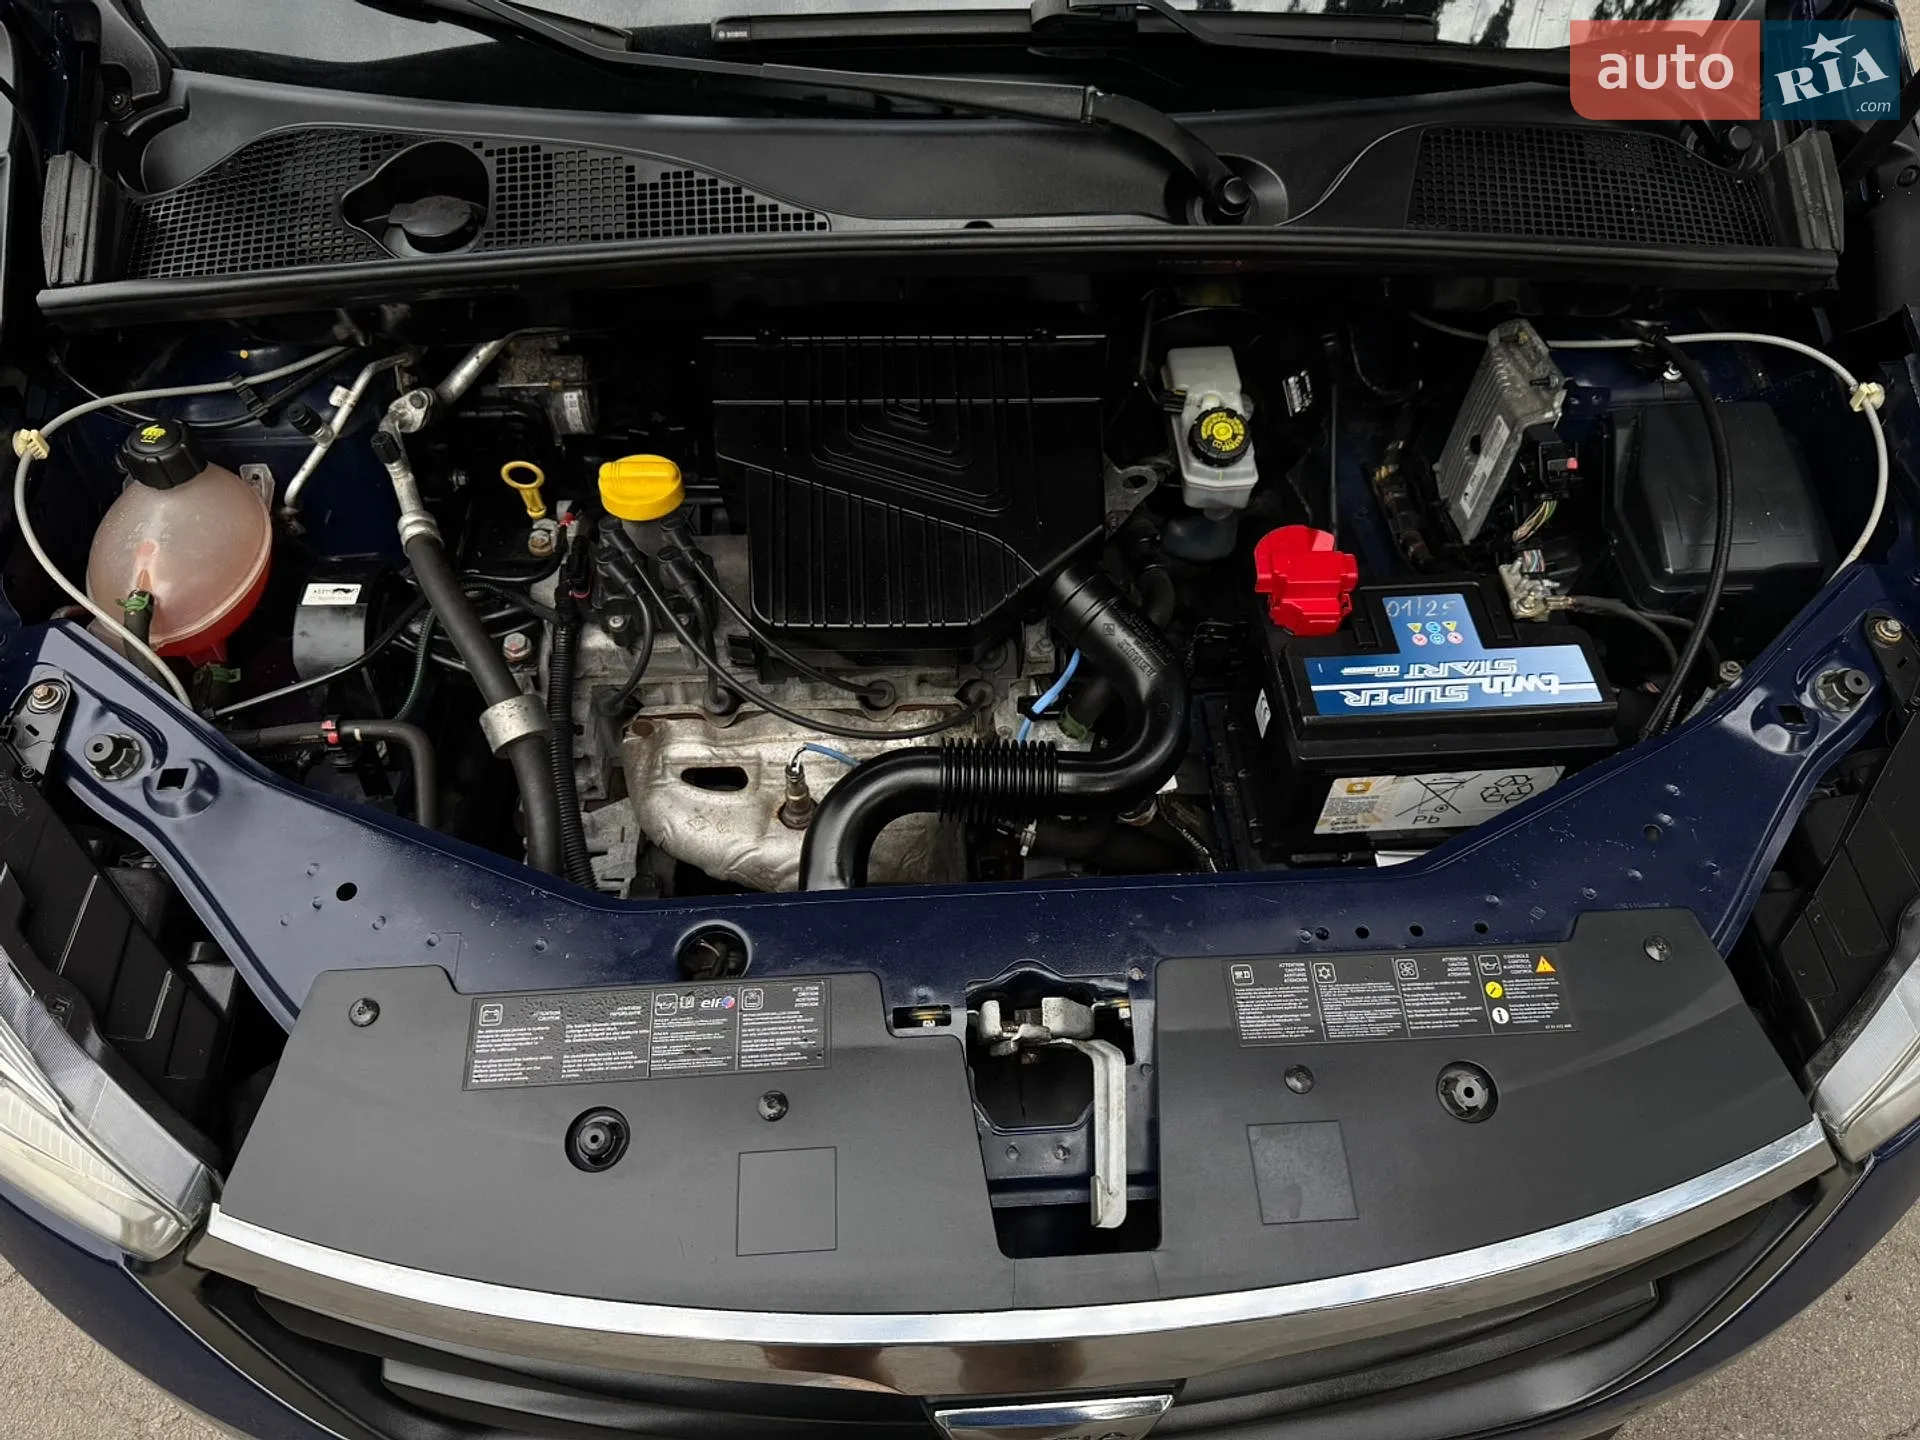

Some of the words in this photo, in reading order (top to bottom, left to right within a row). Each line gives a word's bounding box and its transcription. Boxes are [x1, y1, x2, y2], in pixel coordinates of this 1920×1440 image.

[1405, 659, 1517, 679] START
[1340, 685, 1469, 707] SUPER
[1482, 675, 1560, 697] twin
[1412, 814, 1441, 825] Pb
[701, 998, 724, 1009] elf
